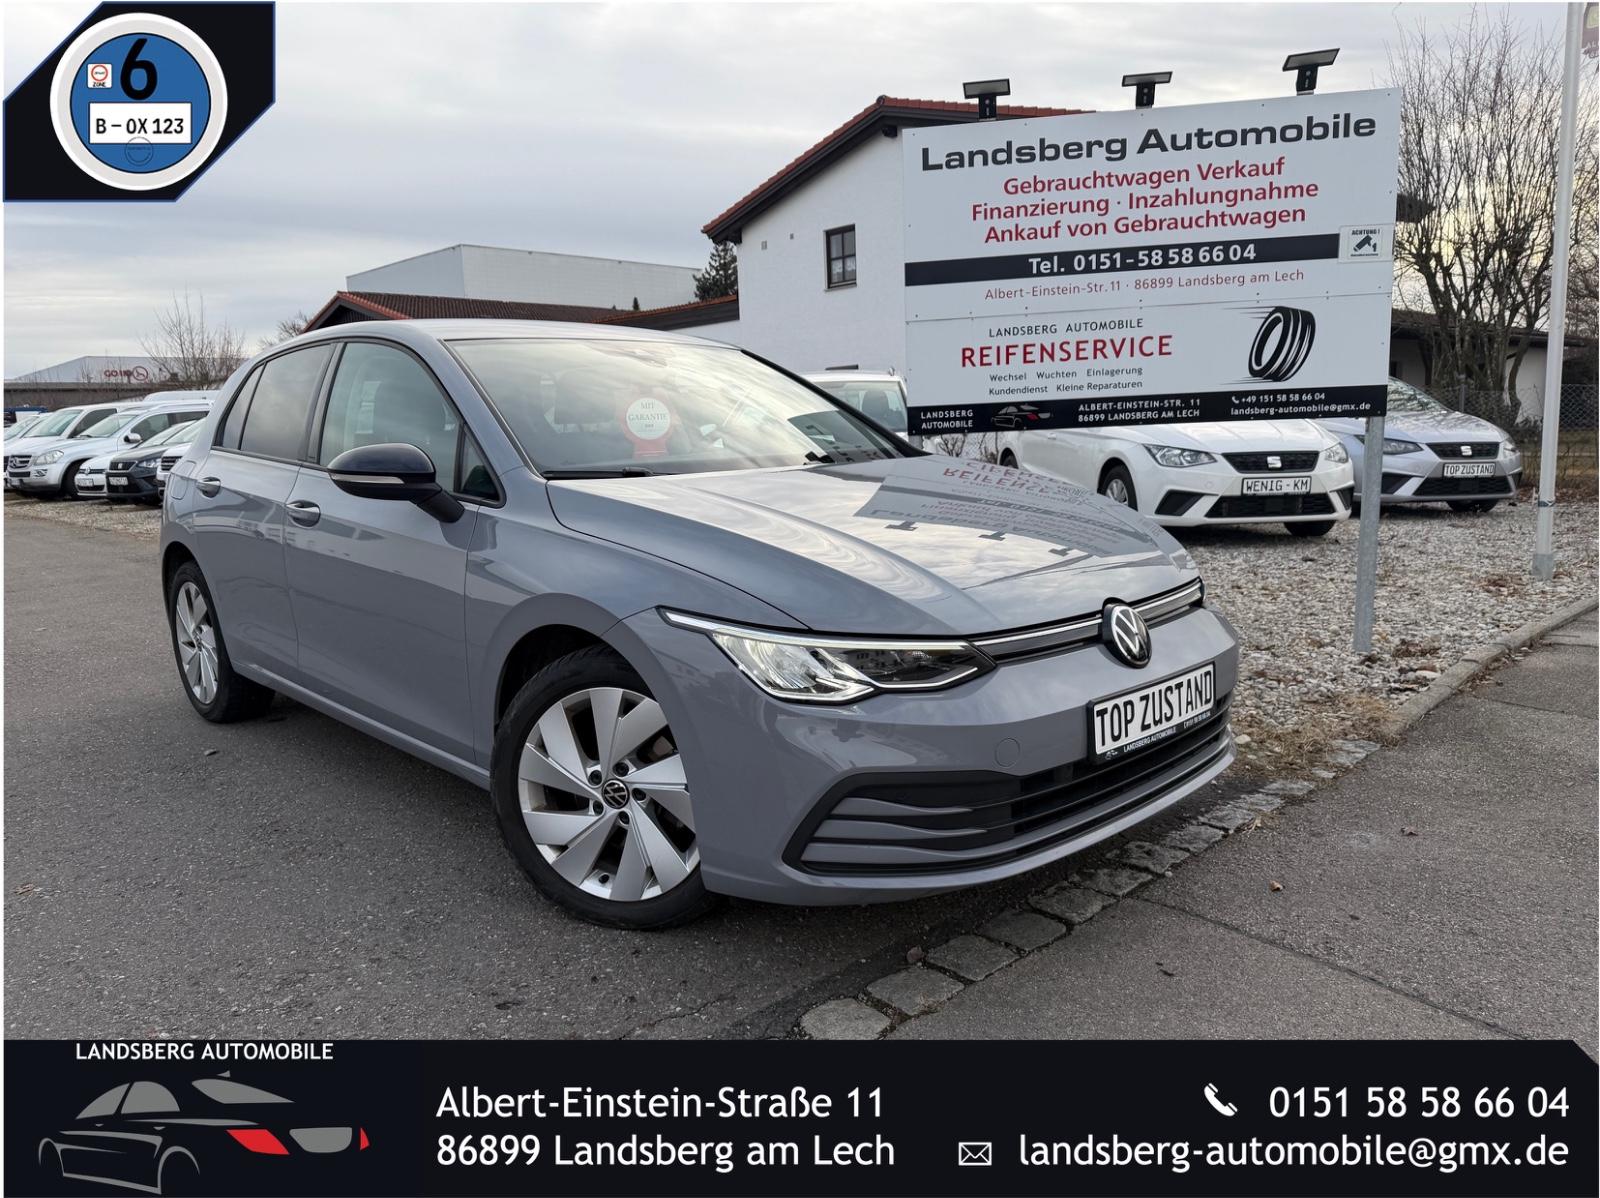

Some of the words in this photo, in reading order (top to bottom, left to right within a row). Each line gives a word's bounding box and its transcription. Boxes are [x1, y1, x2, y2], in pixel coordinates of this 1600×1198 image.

[921, 138, 1127, 171] Landsberg
[1136, 112, 1376, 154] Automobile
[1003, 167, 1190, 195] Gebrauchtwagen
[1197, 156, 1285, 181] Verkauf
[972, 198, 1109, 221] Finanzierung
[1129, 181, 1319, 209] Inzahlungnahme
[984, 220, 1061, 243] Ankauf
[1067, 222, 1107, 237] von
[1114, 207, 1306, 234] Gebrauchtwagen
[1028, 255, 1065, 274] Tel.
[1134, 277, 1173, 290] 86899
[1178, 273, 1245, 287] Landsberg
[1250, 272, 1269, 283] am
[1275, 268, 1304, 282] Lech
[988, 324, 1058, 338] LANDSBERG
[1065, 318, 1144, 333] AUTOMOBILE
[961, 335, 1173, 368] REIFENSERVICE
[989, 372, 1027, 383] Wechsel
[1036, 369, 1077, 380] Wuchten
[1086, 365, 1143, 378] Einlagerung
[988, 384, 1048, 396] Kundendienst
[1056, 382, 1084, 392] Kleine
[1086, 379, 1143, 392] Reparaturen
[1190, 398, 1200, 406] 11
[1259, 394, 1274, 402] 151
[1276, 393, 1287, 402] 58
[1289, 393, 1300, 401] 58
[1302, 392, 1313, 401] 66
[1314, 392, 1326, 400] 04
[920, 409, 974, 419] LANDSBERG
[1078, 413, 1105, 422] 86899
[1108, 410, 1159, 420] LANDSBERG
[1161, 410, 1174, 418] AM
[1176, 408, 1200, 418] LECH
[1230, 401, 1371, 416] landsberg-automobile@gmx.de
[921, 419, 974, 430] AUTOMOBILE
[1445, 465, 1461, 475] TOP
[1461, 464, 1495, 475] ZUSTAND
[1246, 480, 1283, 492] WENIG
[1293, 479, 1309, 490] KM
[1096, 700, 1135, 746] TOP
[1139, 670, 1212, 732] ZUSTAND
